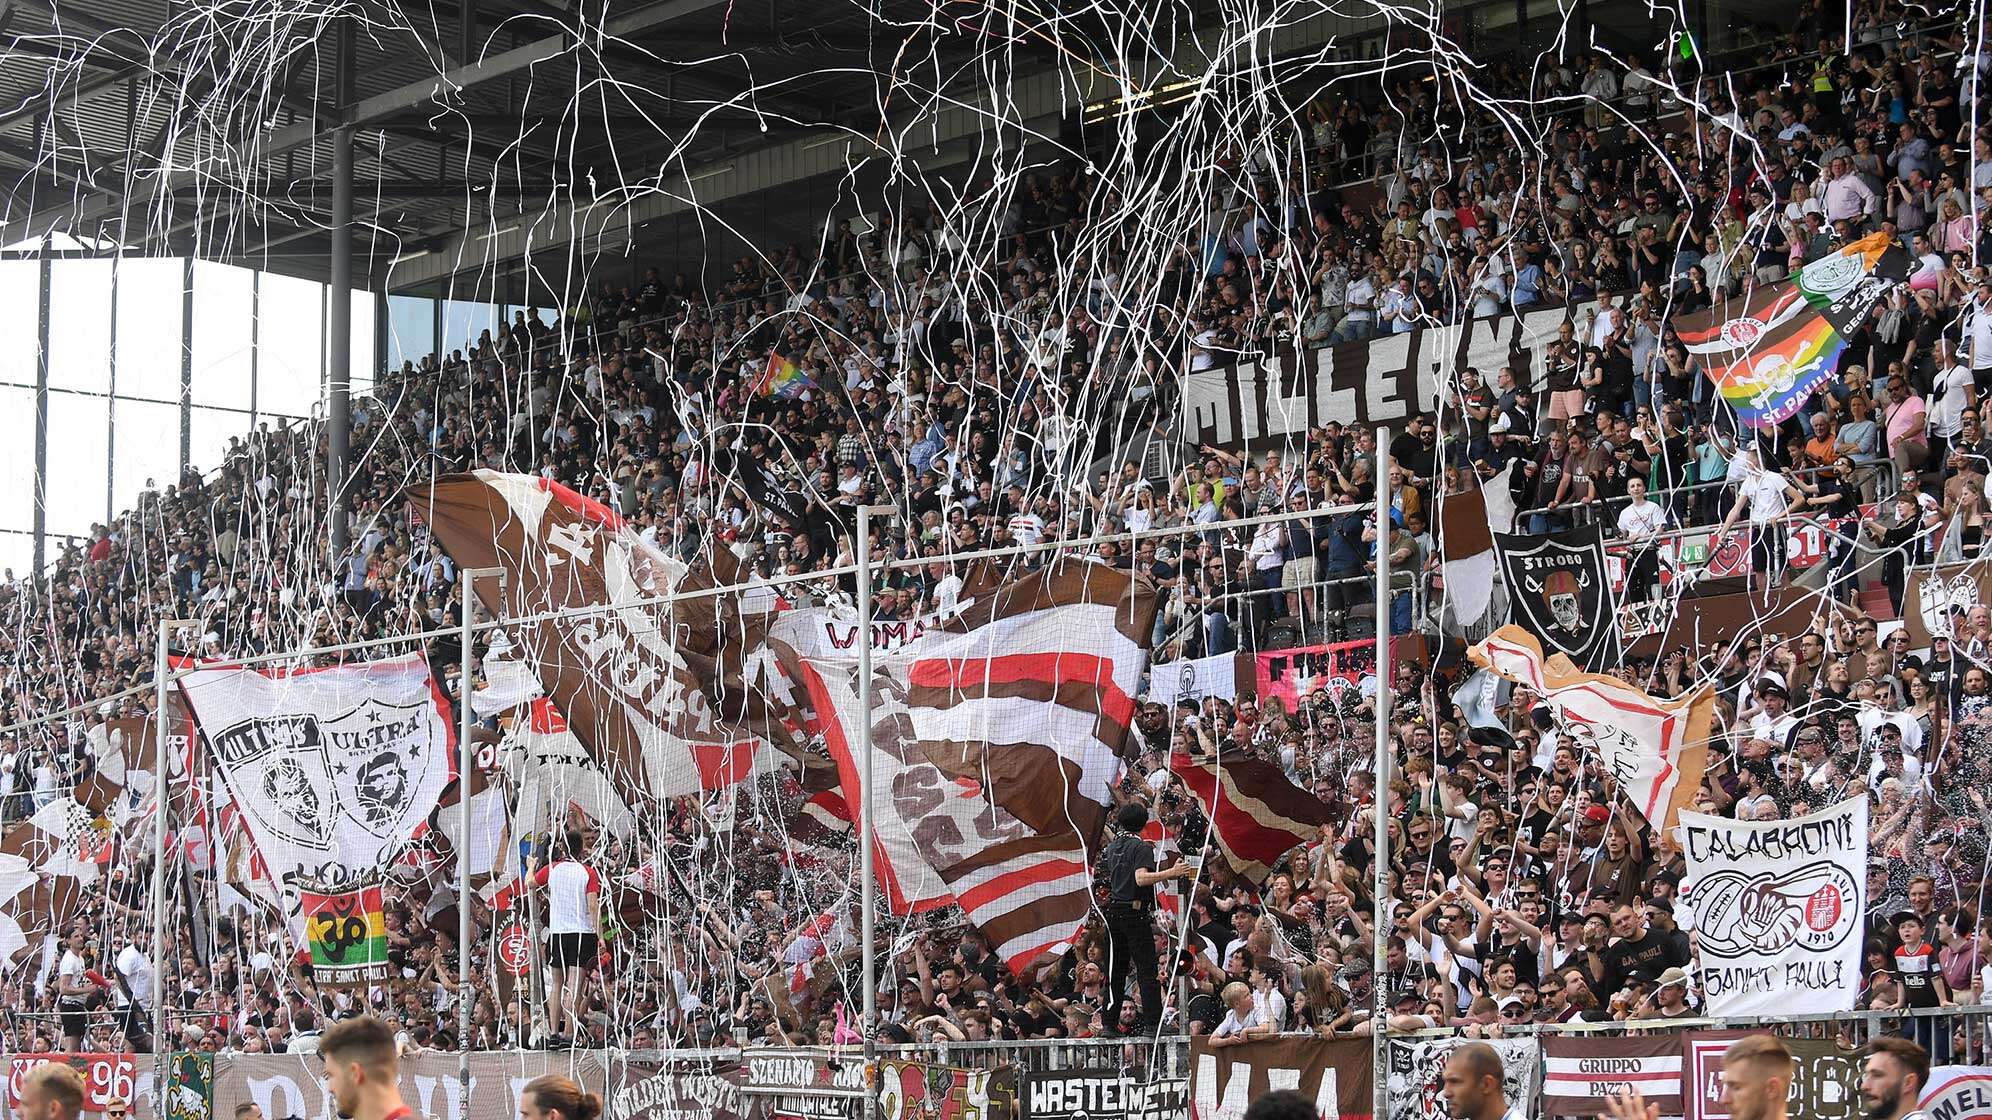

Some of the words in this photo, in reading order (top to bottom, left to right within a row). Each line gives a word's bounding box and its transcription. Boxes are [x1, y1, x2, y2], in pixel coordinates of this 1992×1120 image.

[1523, 553, 1582, 571] STROBO
[1687, 812, 1856, 863] CALABRONI
[1807, 931, 1835, 945] 1910
[335, 969, 360, 984] SANKT
[363, 966, 388, 982] PAULI
[1704, 965, 1778, 996] SANKT
[1785, 959, 1846, 992] PAULI
[749, 1058, 815, 1087] SZENARIO
[1578, 1058, 1642, 1073] GRUPPO
[91, 1061, 133, 1106] 96
[1128, 1082, 1188, 1111] METT
